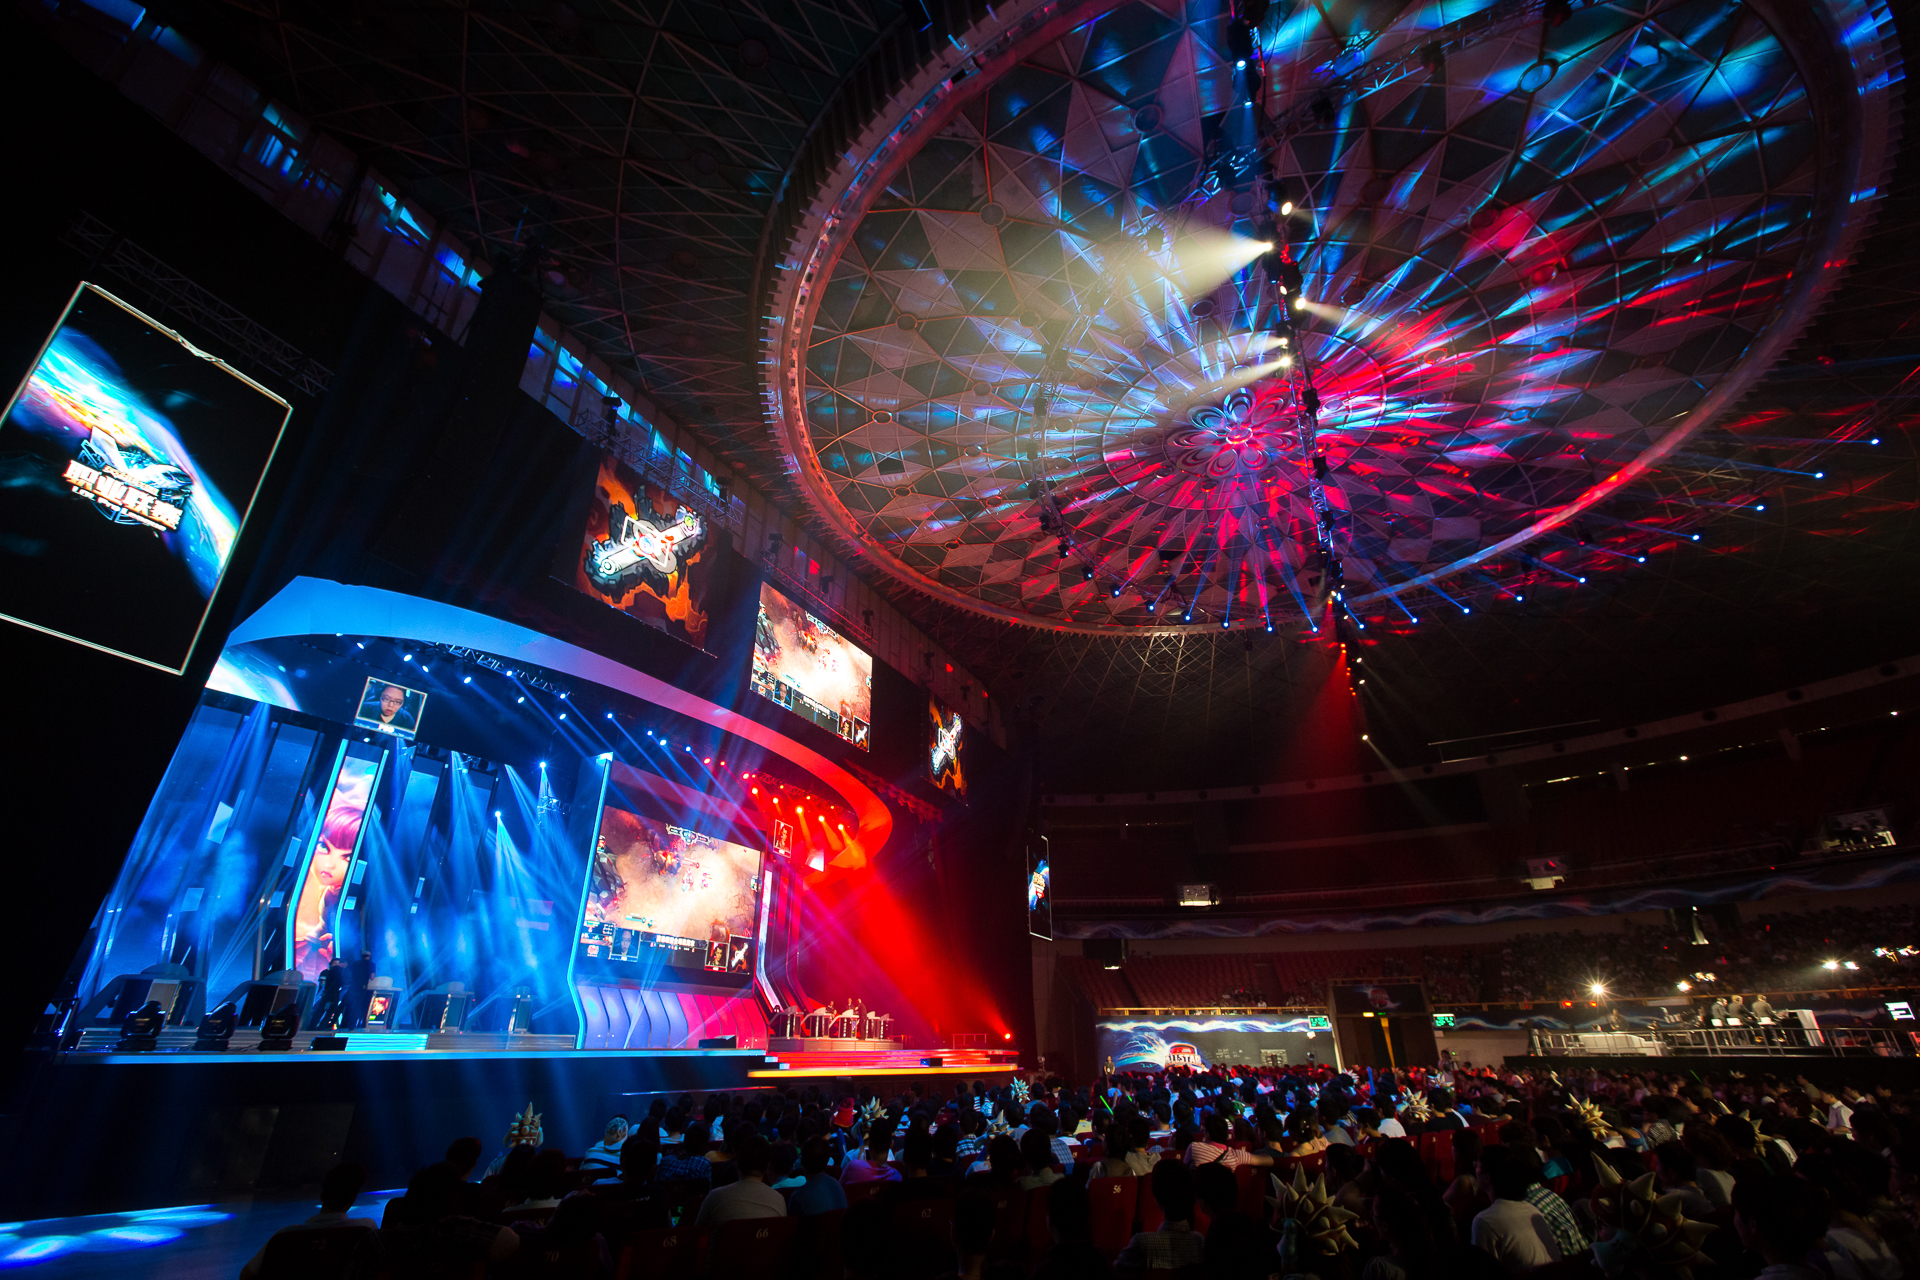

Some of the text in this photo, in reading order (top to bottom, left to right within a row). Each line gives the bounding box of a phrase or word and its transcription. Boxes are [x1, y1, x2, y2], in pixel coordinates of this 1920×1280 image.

[1112, 1184, 1122, 1194] 56
[920, 1207, 932, 1219] 62
[755, 1227, 770, 1240] 66
[311, 1238, 327, 1251] 72
[662, 1235, 678, 1248] 68
[543, 1250, 560, 1263] 70
[425, 1260, 443, 1274] 72
